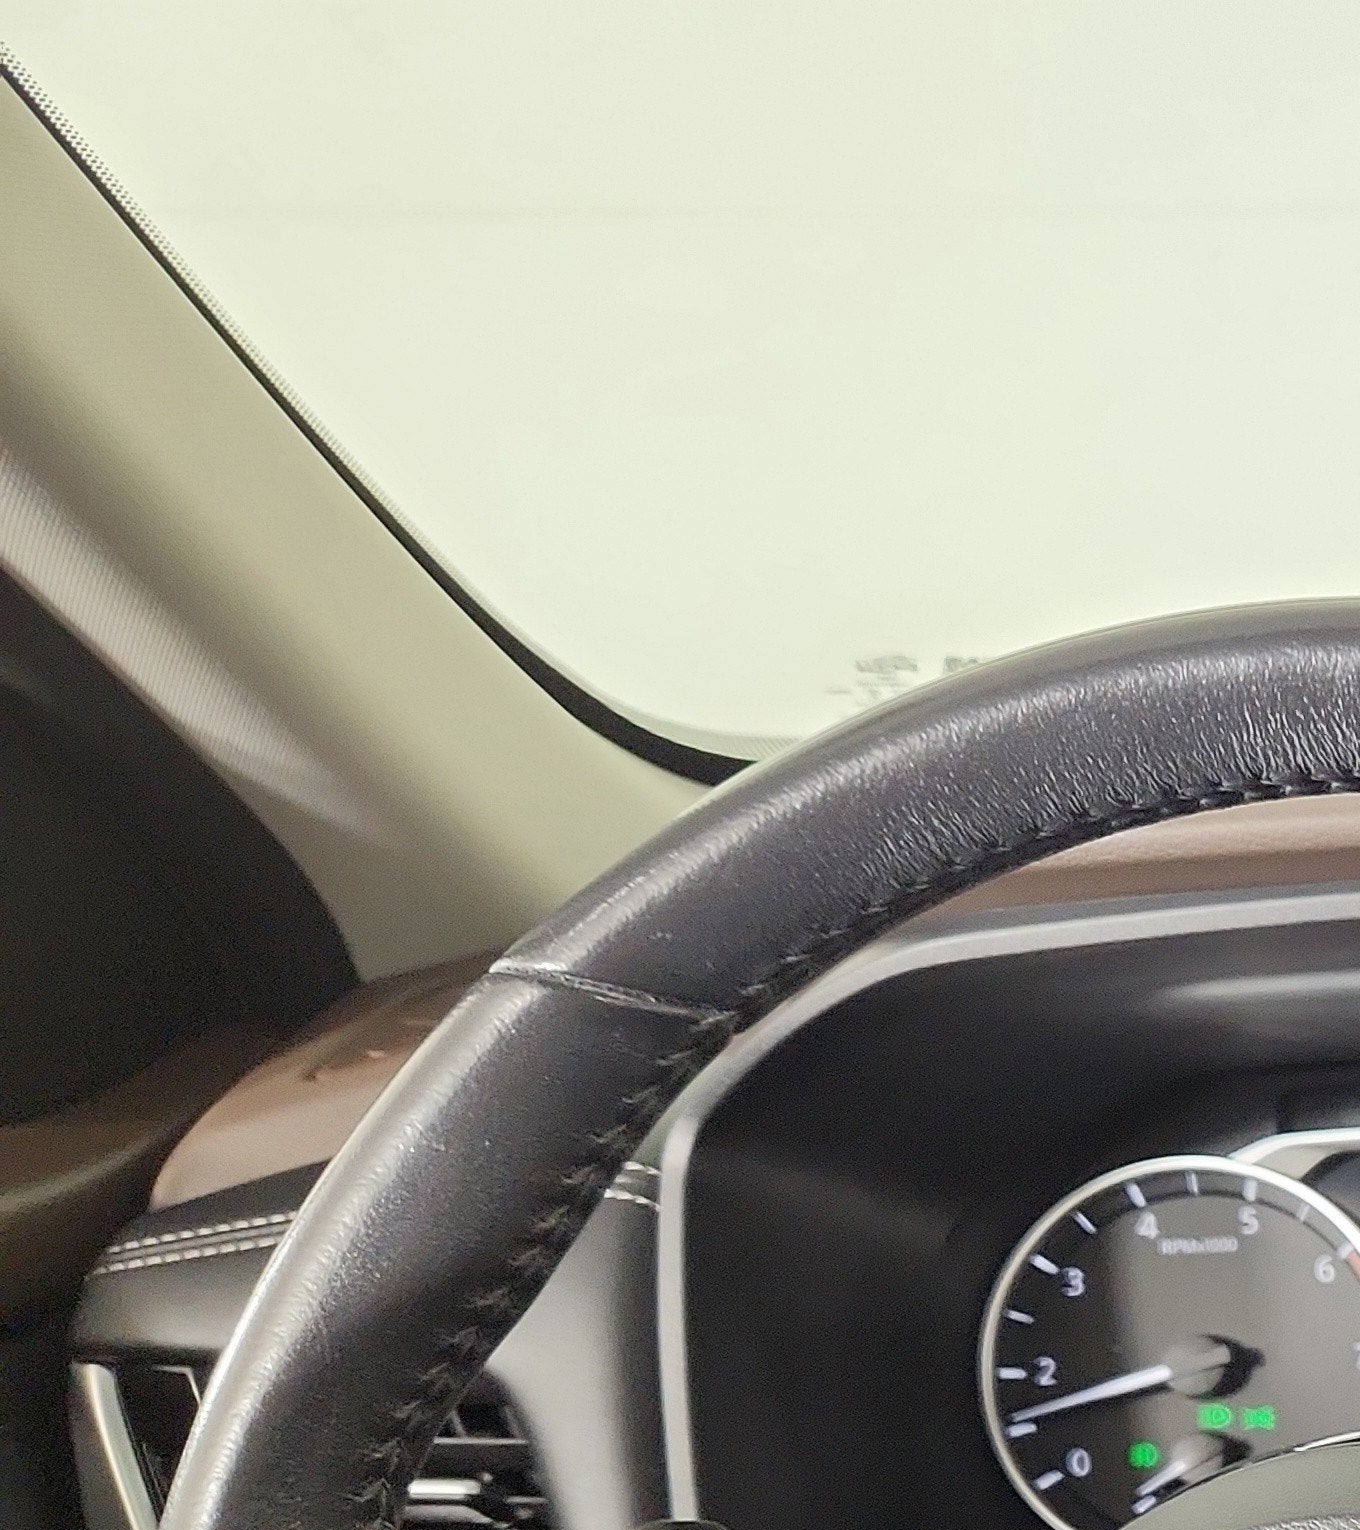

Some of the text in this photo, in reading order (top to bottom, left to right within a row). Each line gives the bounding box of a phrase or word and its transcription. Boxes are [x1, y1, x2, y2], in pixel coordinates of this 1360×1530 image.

[1135, 1211, 1158, 1240] 4
[1238, 1205, 1260, 1236] 5
[1061, 1266, 1086, 1298] 3
[1314, 1255, 1336, 1283] 6
[1032, 1357, 1058, 1386] 2
[1065, 1447, 1093, 1477] 0
